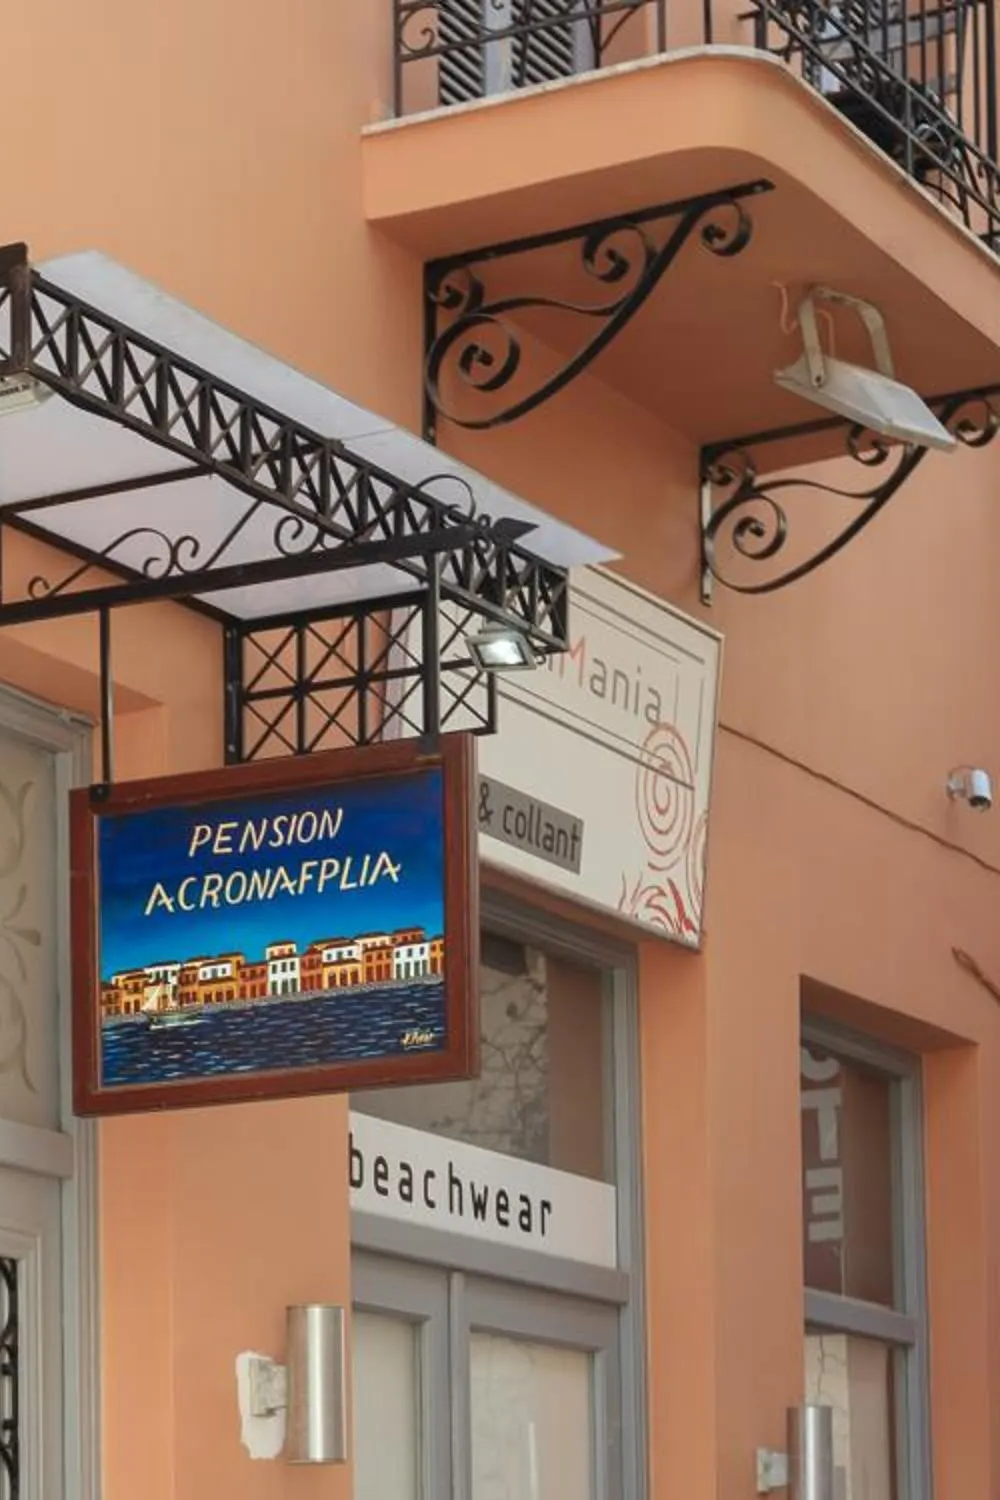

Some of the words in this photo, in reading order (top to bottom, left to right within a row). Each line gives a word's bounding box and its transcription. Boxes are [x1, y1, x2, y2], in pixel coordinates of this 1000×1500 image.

[188, 807, 344, 857] PENSION
[478, 781, 494, 824] &
[502, 799, 581, 863] collant
[144, 851, 401, 916] ACRONAFPLIA
[349, 1131, 553, 1237] beachwear
